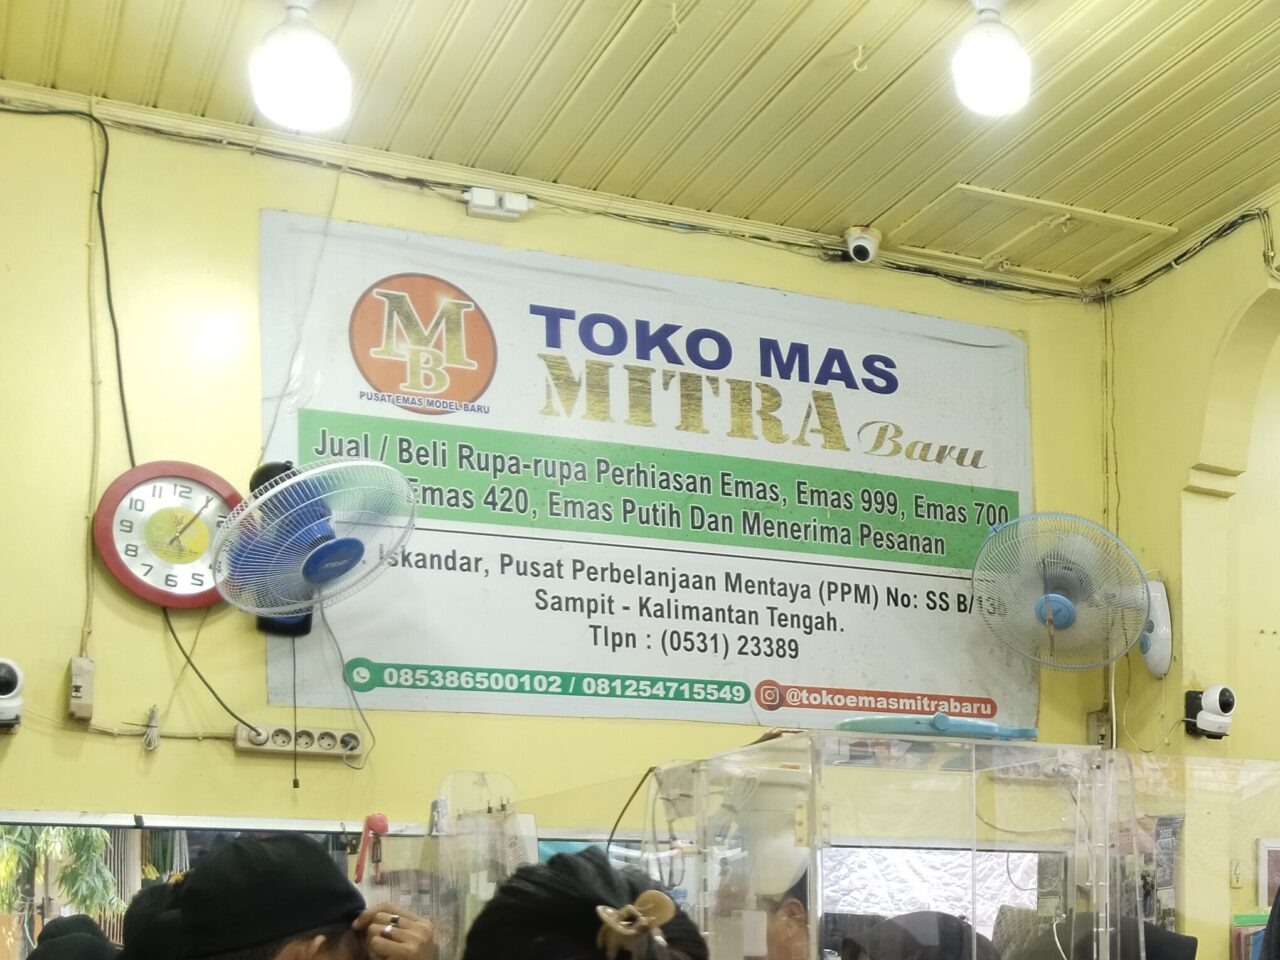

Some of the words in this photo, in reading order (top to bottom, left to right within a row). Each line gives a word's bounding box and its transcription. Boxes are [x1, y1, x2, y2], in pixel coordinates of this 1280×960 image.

[529, 304, 733, 370] TOKO
[759, 338, 899, 394] MAS
[360, 391, 391, 404] PUSAT
[395, 396, 423, 407] EMAS
[426, 399, 460, 411] MODEL
[463, 403, 490, 414] BARU
[537, 353, 851, 452] MITRA
[857, 420, 988, 470] Baru
[173, 483, 194, 499] 12
[314, 429, 369, 458] Jual
[398, 437, 447, 467] Beli
[458, 443, 587, 486] Rupa-rupa
[596, 458, 711, 494] Perhiasan
[720, 472, 787, 507] Emas,
[796, 481, 853, 510] Emas
[861, 489, 905, 520] 999,
[914, 495, 967, 524] Emas
[974, 502, 1008, 527] 700
[128, 497, 145, 512] 10
[119, 519, 134, 533] 9
[483, 485, 538, 520] 420,
[548, 491, 613, 522] Emas
[622, 499, 681, 528] Putih
[690, 505, 733, 533] Dan
[742, 510, 851, 545] Menerima
[860, 523, 945, 555] Pesanan
[124, 545, 139, 557] 8
[140, 563, 154, 577] 7
[164, 574, 178, 587] 6
[191, 573, 205, 587] 5
[500, 553, 564, 579] Pusat
[572, 558, 716, 593] Perbelanjaan
[725, 571, 811, 604] Mentaya
[818, 580, 879, 610] (PPM)
[887, 587, 918, 609] No:
[926, 590, 950, 612] SS
[535, 589, 615, 619] Sampit
[639, 597, 759, 626] Kalimantan
[767, 606, 845, 635] Tengah.
[589, 625, 637, 652] Tlpn
[661, 629, 729, 659] (0531)
[737, 635, 799, 659] 23389
[383, 667, 562, 693] 085386500102
[582, 677, 746, 702] 081254715549
[786, 687, 992, 715] @tokoemasmitrabaru
